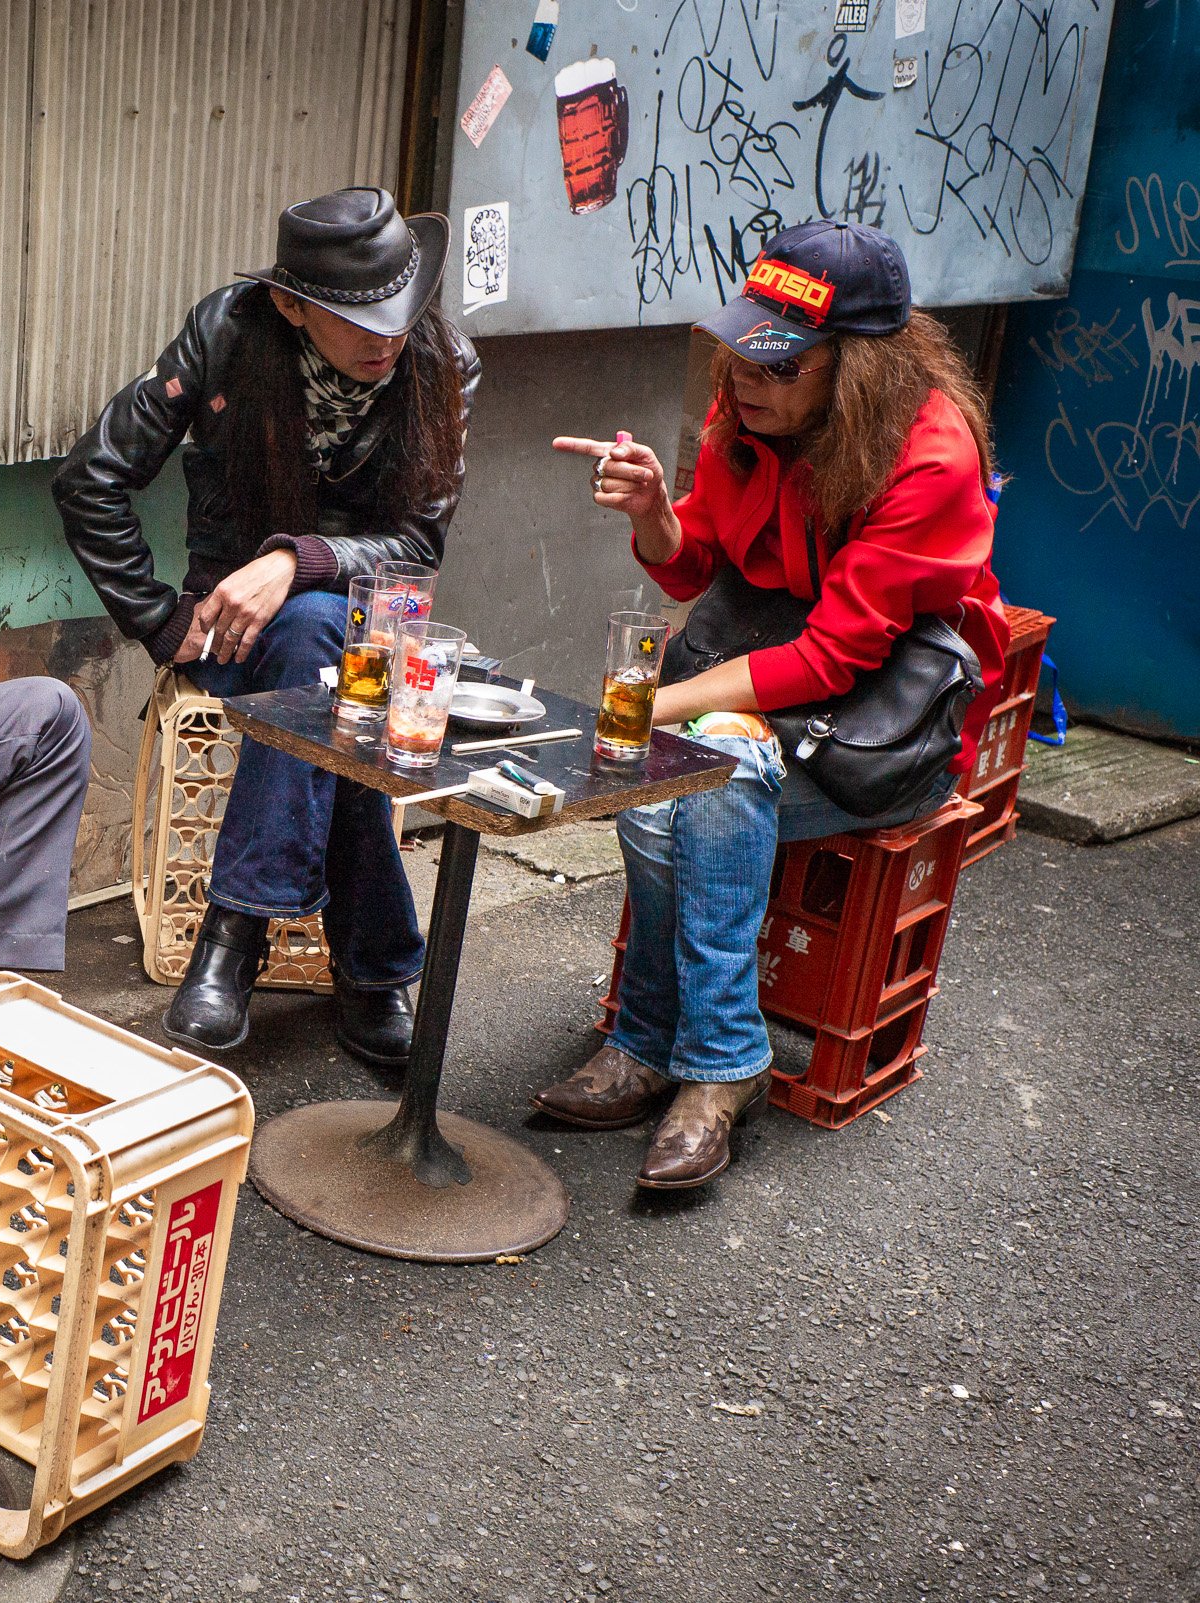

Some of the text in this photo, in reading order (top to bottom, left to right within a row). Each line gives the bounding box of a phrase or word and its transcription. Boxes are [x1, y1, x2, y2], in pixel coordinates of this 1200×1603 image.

[749, 341, 790, 350] ALONSO
[143, 1202, 196, 1415] アサヒビール
